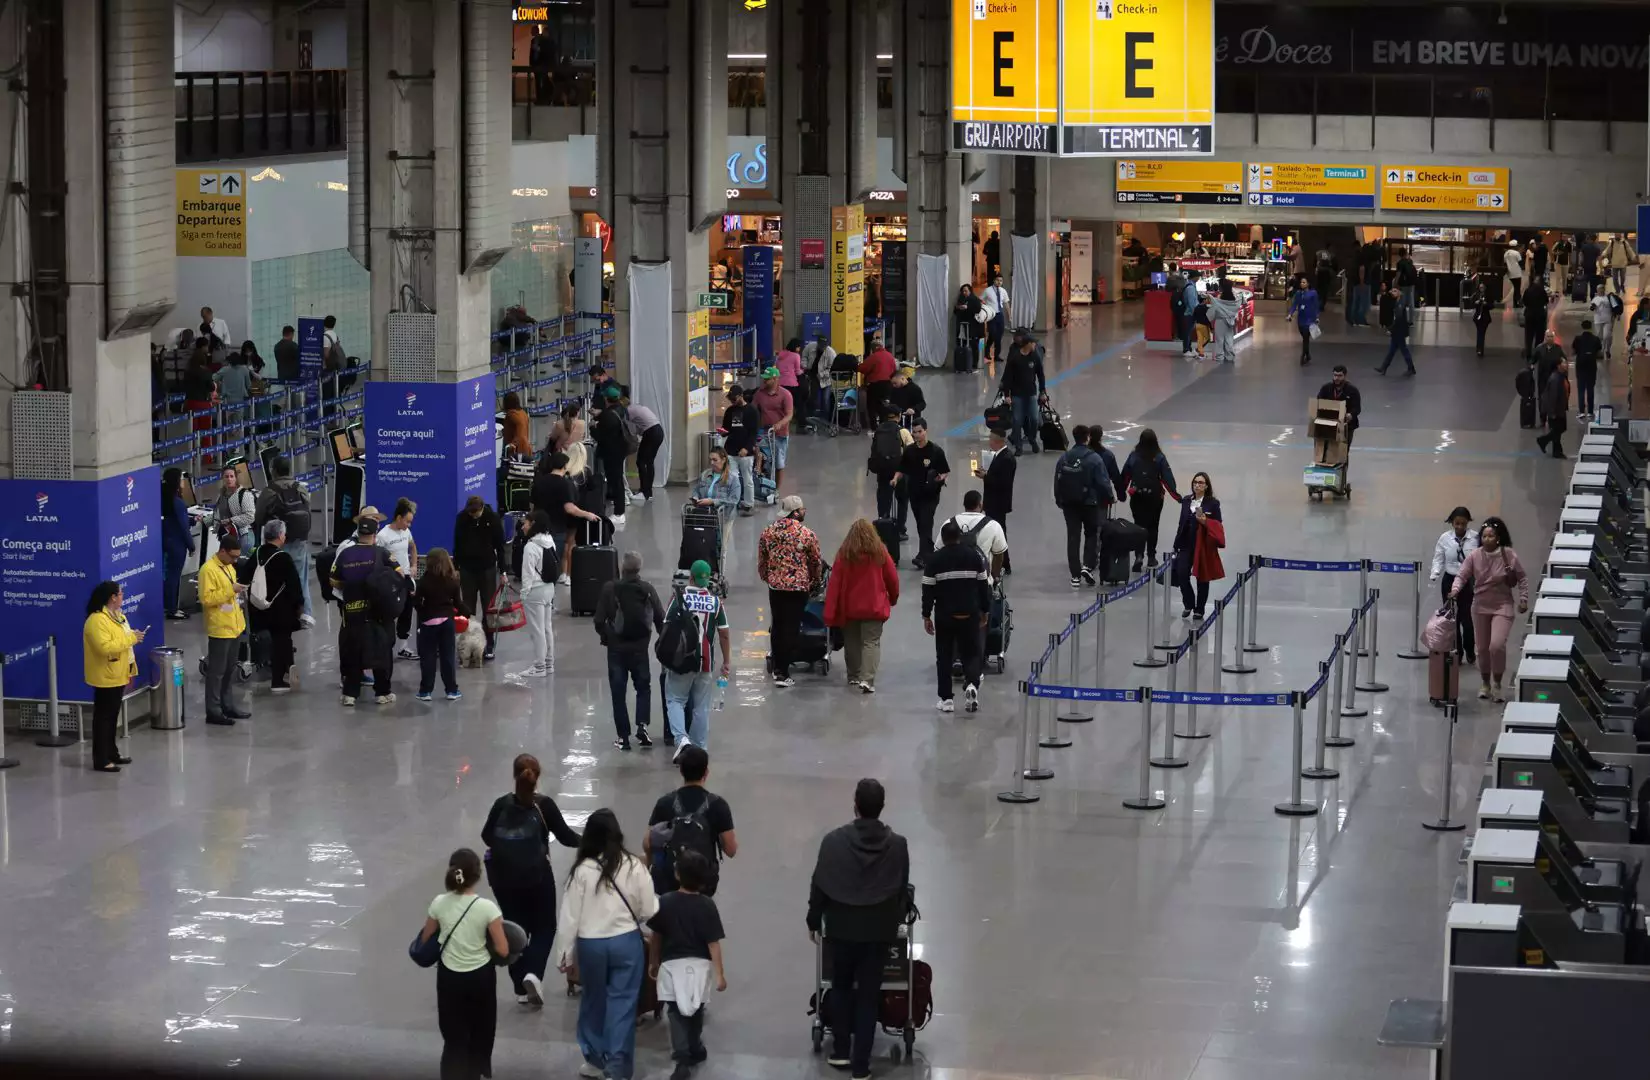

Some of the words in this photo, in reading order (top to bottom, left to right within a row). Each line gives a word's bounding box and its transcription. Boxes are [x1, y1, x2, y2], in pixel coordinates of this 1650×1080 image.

[518, 6, 548, 20] COWORK
[988, 4, 1017, 13] Check-in
[1117, 4, 1158, 14] Check-in
[1234, 25, 1332, 64] Doces
[1373, 40, 1411, 64] EM
[1418, 40, 1505, 65] BREVE
[1512, 42, 1573, 66] UMA
[994, 31, 1014, 97] E
[1125, 32, 1154, 98] E
[965, 122, 989, 146] GRU
[991, 124, 1049, 150] AIRPORT
[1098, 128, 1187, 149] TERMINAL
[1192, 128, 1199, 148] 2
[1418, 172, 1462, 182] Check-in
[869, 191, 895, 200] PIZZA
[1396, 194, 1436, 203] Elevador
[1444, 196, 1474, 204] Elevator
[182, 200, 241, 213] Embarque
[177, 214, 241, 228] Departures
[836, 220, 843, 230] 2
[181, 230, 199, 241] Siga
[216, 230, 242, 239] frente
[218, 241, 242, 249] ahead
[836, 240, 843, 254] E
[834, 262, 844, 313] Check-in
[471, 402, 482, 410] LATAM
[378, 428, 410, 439] Começa
[413, 429, 434, 440] aqui!
[465, 426, 479, 436] Começa
[479, 420, 488, 434] aqui!
[121, 502, 139, 514] LATAM
[112, 534, 134, 548] Começa
[133, 525, 148, 544] aqui!
[2, 539, 42, 552] Começa
[46, 540, 71, 553] aqui!
[3, 569, 52, 577] Autoatendimento
[686, 595, 712, 603] AME
